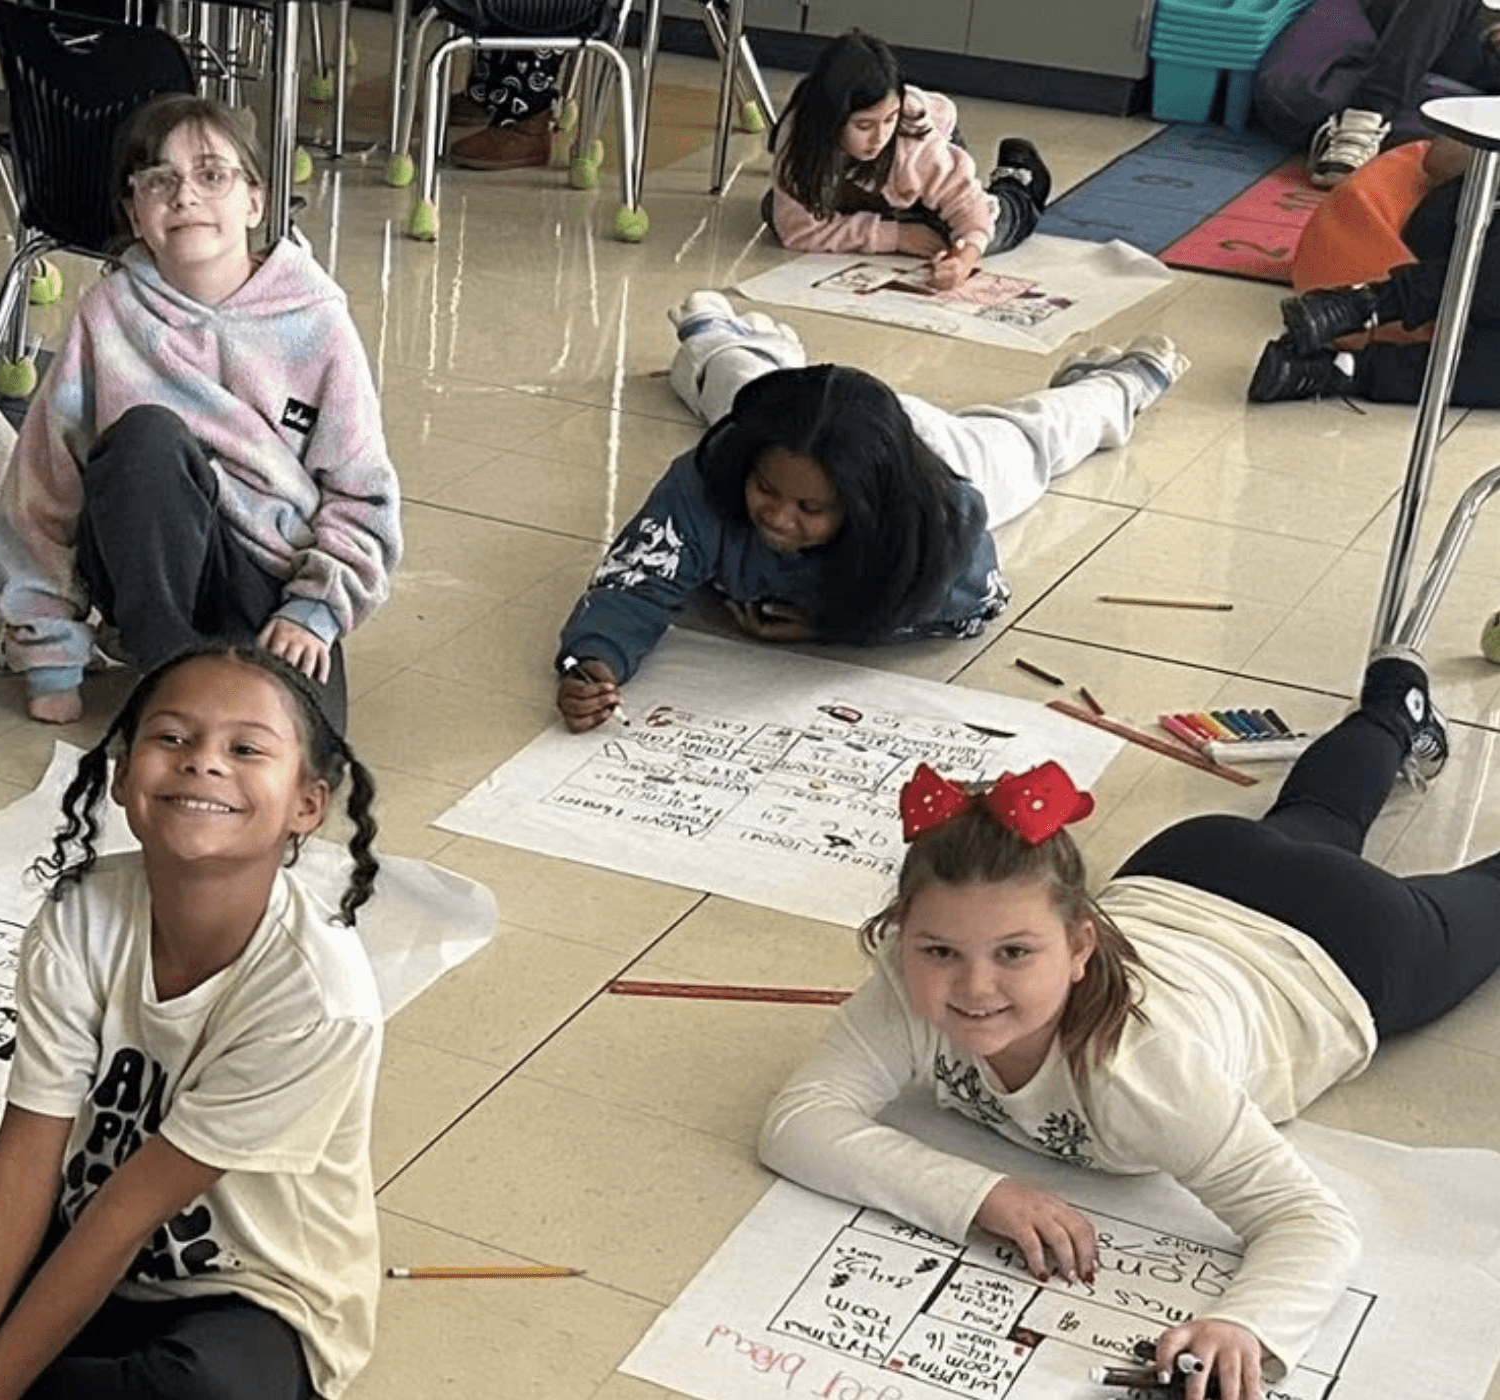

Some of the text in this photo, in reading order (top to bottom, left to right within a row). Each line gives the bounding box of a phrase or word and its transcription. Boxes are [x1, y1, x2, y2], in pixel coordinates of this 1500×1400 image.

[1218, 239, 1290, 259] 2
[824, 1293, 892, 1327] room
[945, 1354, 1002, 1381] room
